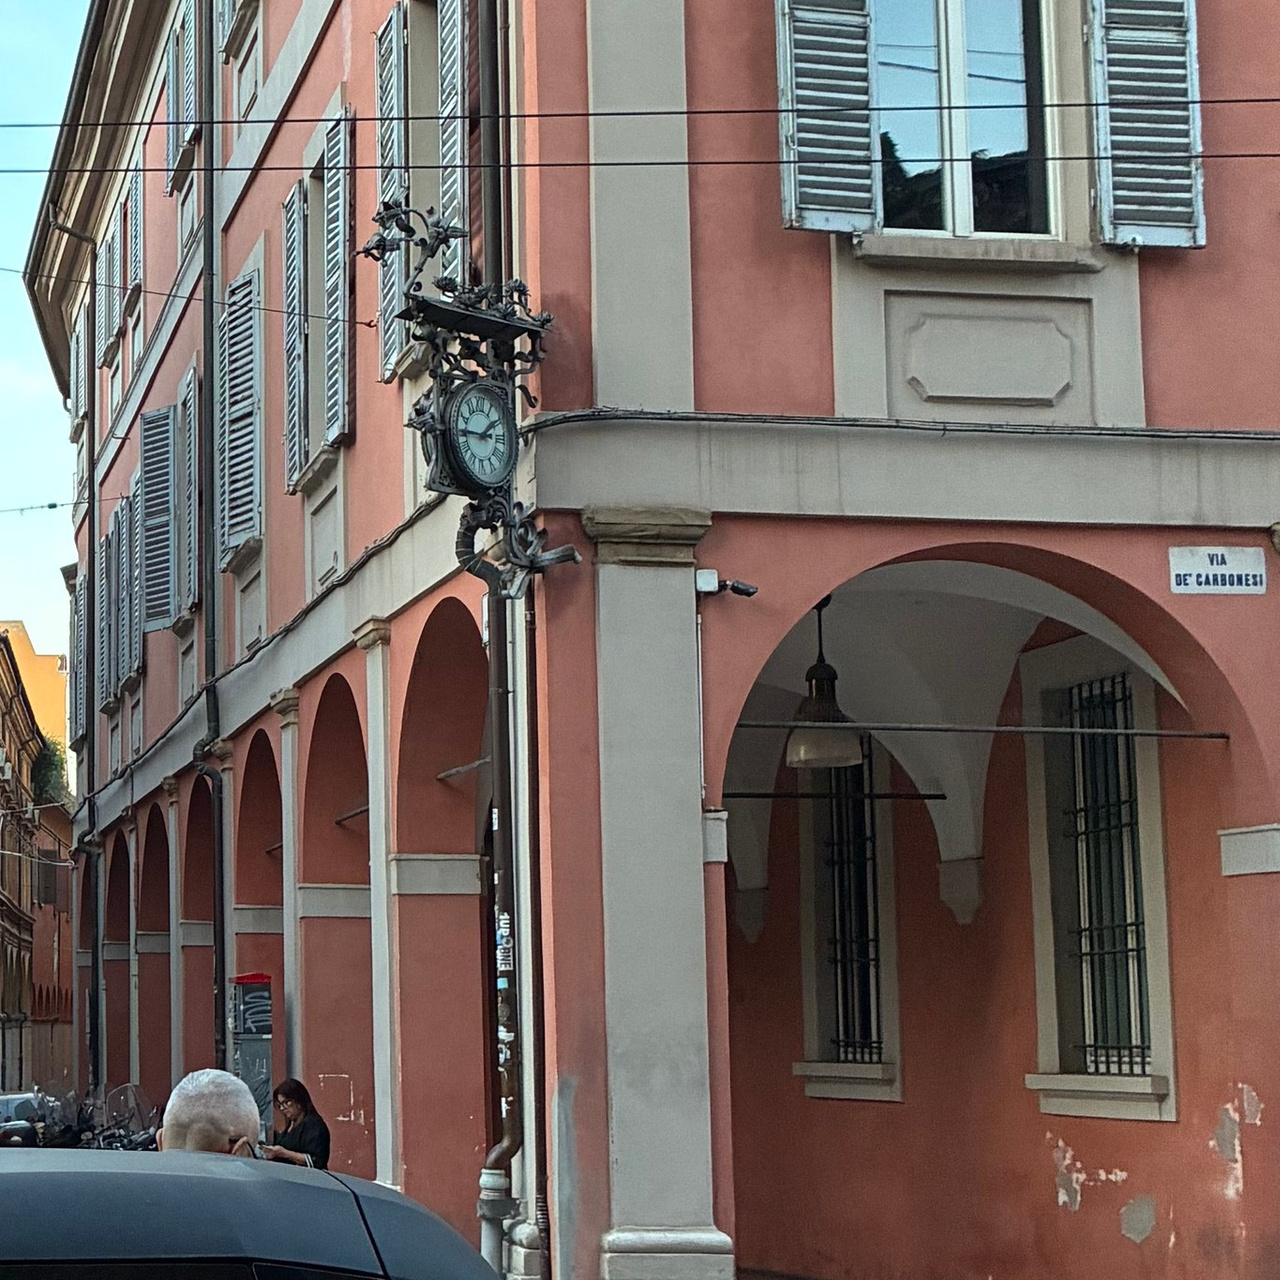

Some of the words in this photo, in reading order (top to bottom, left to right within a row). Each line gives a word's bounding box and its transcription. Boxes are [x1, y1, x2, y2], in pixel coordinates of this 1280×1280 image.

[1208, 553, 1227, 566] VIA
[1175, 573, 1192, 587] DE'
[1196, 573, 1263, 587] CARBONESI
